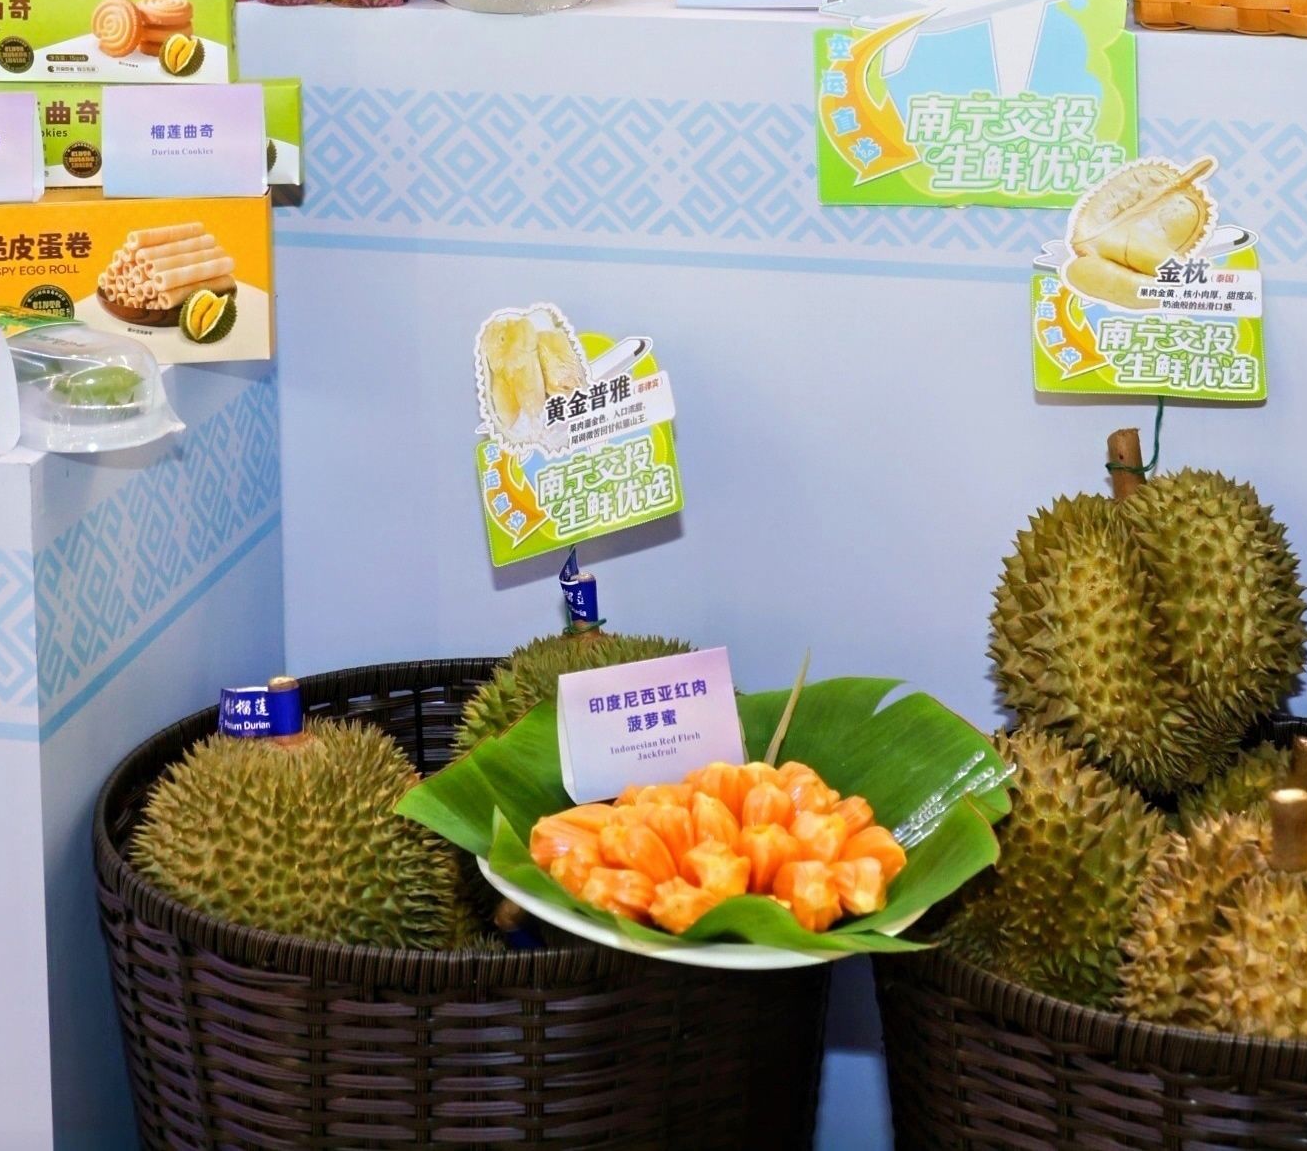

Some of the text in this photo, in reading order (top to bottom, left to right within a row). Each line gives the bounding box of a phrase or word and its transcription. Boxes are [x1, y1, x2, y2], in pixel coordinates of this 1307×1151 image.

[150, 124, 215, 140] 榴莲曲奇
[906, 93, 1099, 145] 南宁交投
[179, 147, 214, 156] Cookies
[928, 141, 1126, 194] 生鲜优选
[19, 264, 45, 275] EGG
[48, 264, 80, 275] ROLL
[1157, 257, 1211, 284] 金枕
[1097, 317, 1237, 355] 南宁交投
[1113, 352, 1255, 390] 生鲜优选
[545, 375, 631, 426] 黄金普雅
[537, 436, 653, 506] 南宁交投
[552, 468, 673, 537] 生鲜优选
[589, 679, 707, 714] 印度尼西亚红肉
[627, 709, 677, 733] 菠萝蜜
[610, 731, 701, 755] Indonesian Red Flesh
[638, 747, 677, 761] Jackfruit
